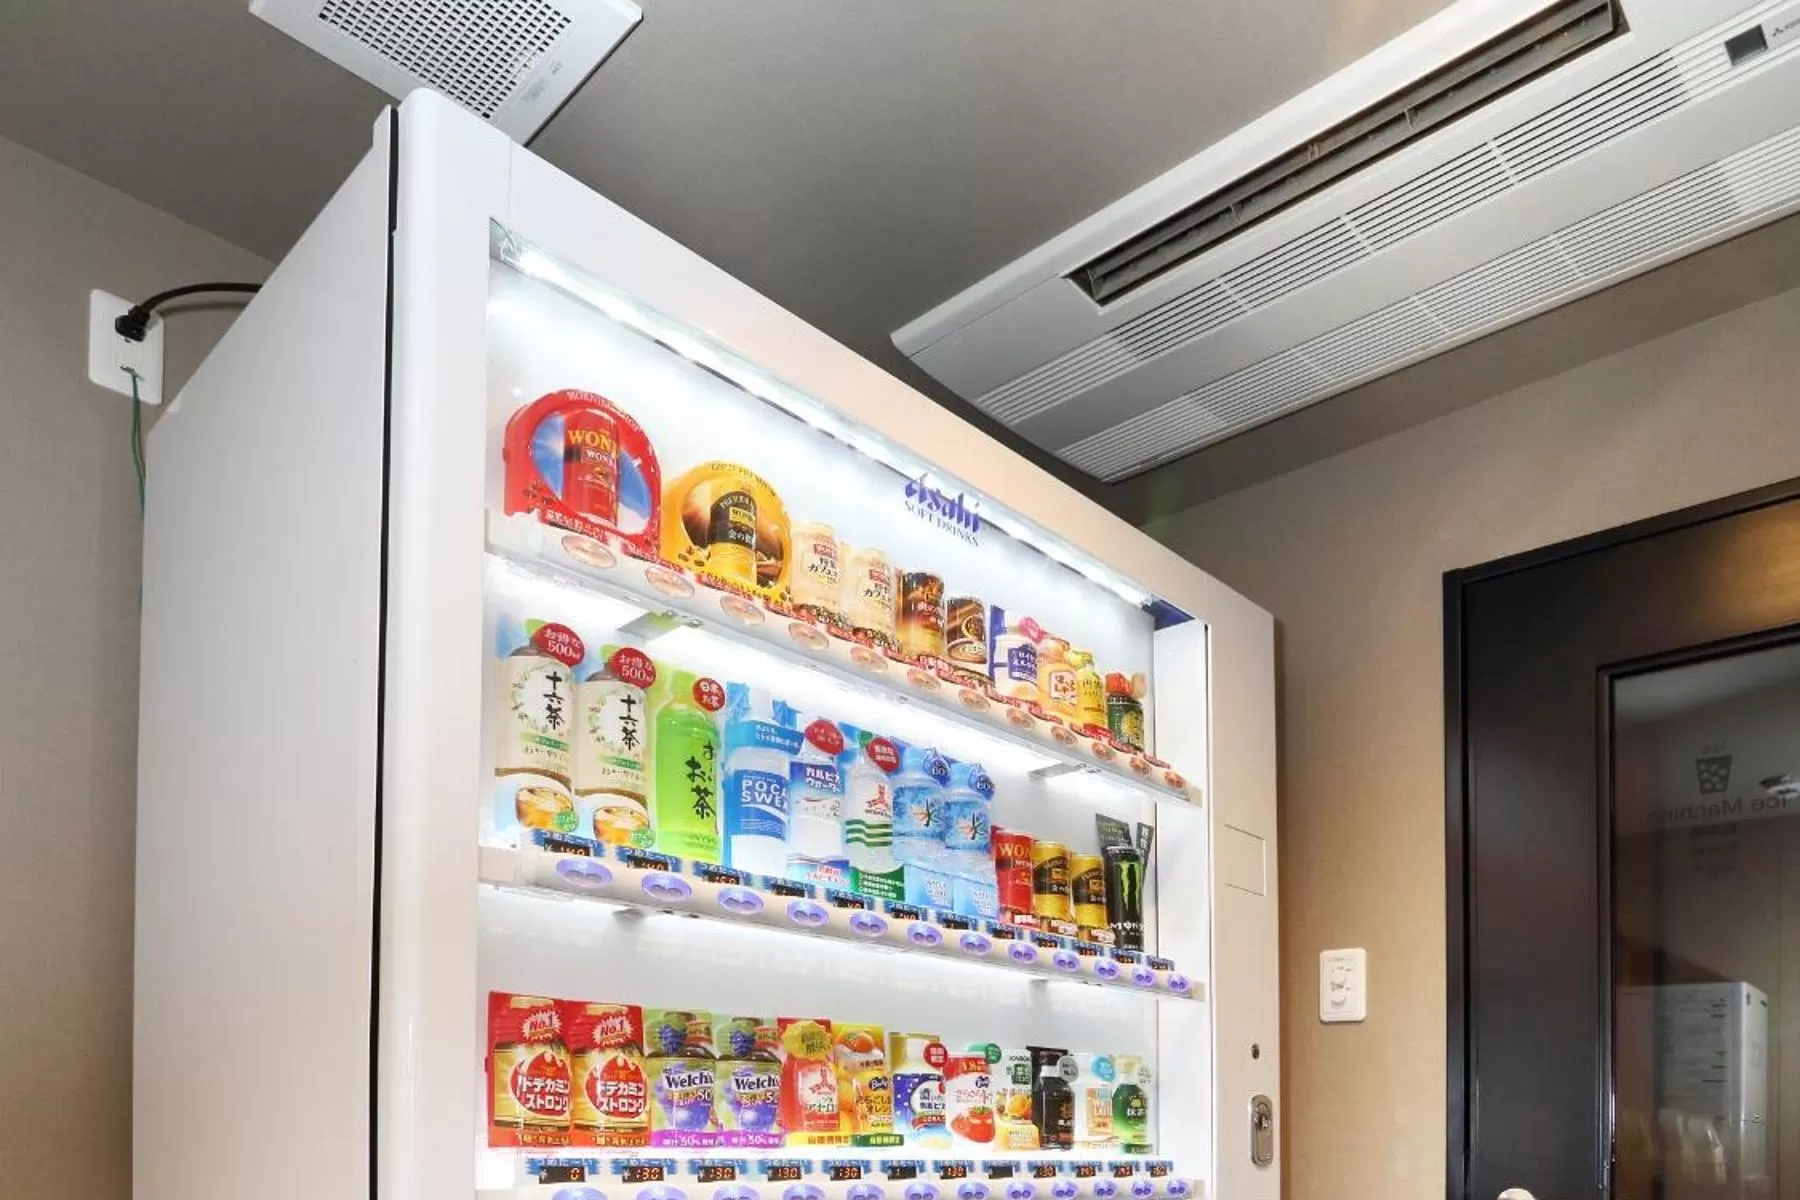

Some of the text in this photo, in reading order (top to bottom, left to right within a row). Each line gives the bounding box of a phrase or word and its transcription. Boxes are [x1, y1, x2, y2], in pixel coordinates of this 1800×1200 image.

[543, 671, 565, 730] 十六茶
[619, 694, 640, 751] 十六茶
[685, 756, 718, 820] お茶
